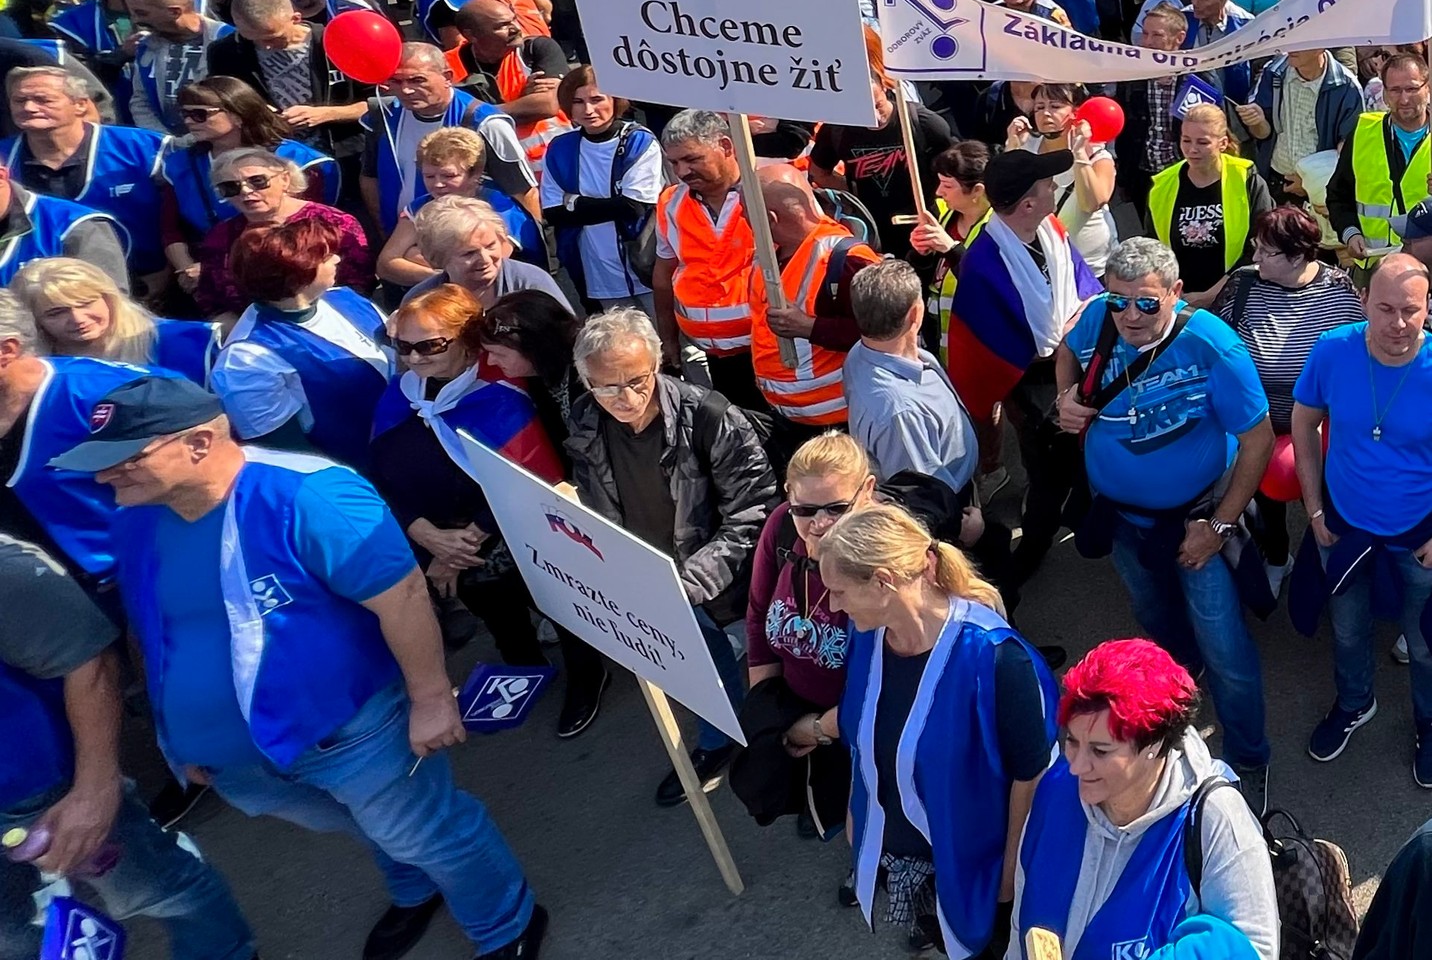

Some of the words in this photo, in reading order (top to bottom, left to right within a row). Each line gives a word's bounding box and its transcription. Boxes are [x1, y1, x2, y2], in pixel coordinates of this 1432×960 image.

[640, 0, 803, 48] Chceme
[887, 19, 925, 54] ODBOROVÝ
[612, 35, 779, 91] dôstojne
[789, 56, 843, 93] žiť
[1131, 364, 1199, 393] TEAM
[525, 543, 622, 616] Zmrazte
[626, 611, 685, 661] ceny,
[572, 602, 609, 633] nie
[609, 619, 667, 671] ľudí!
